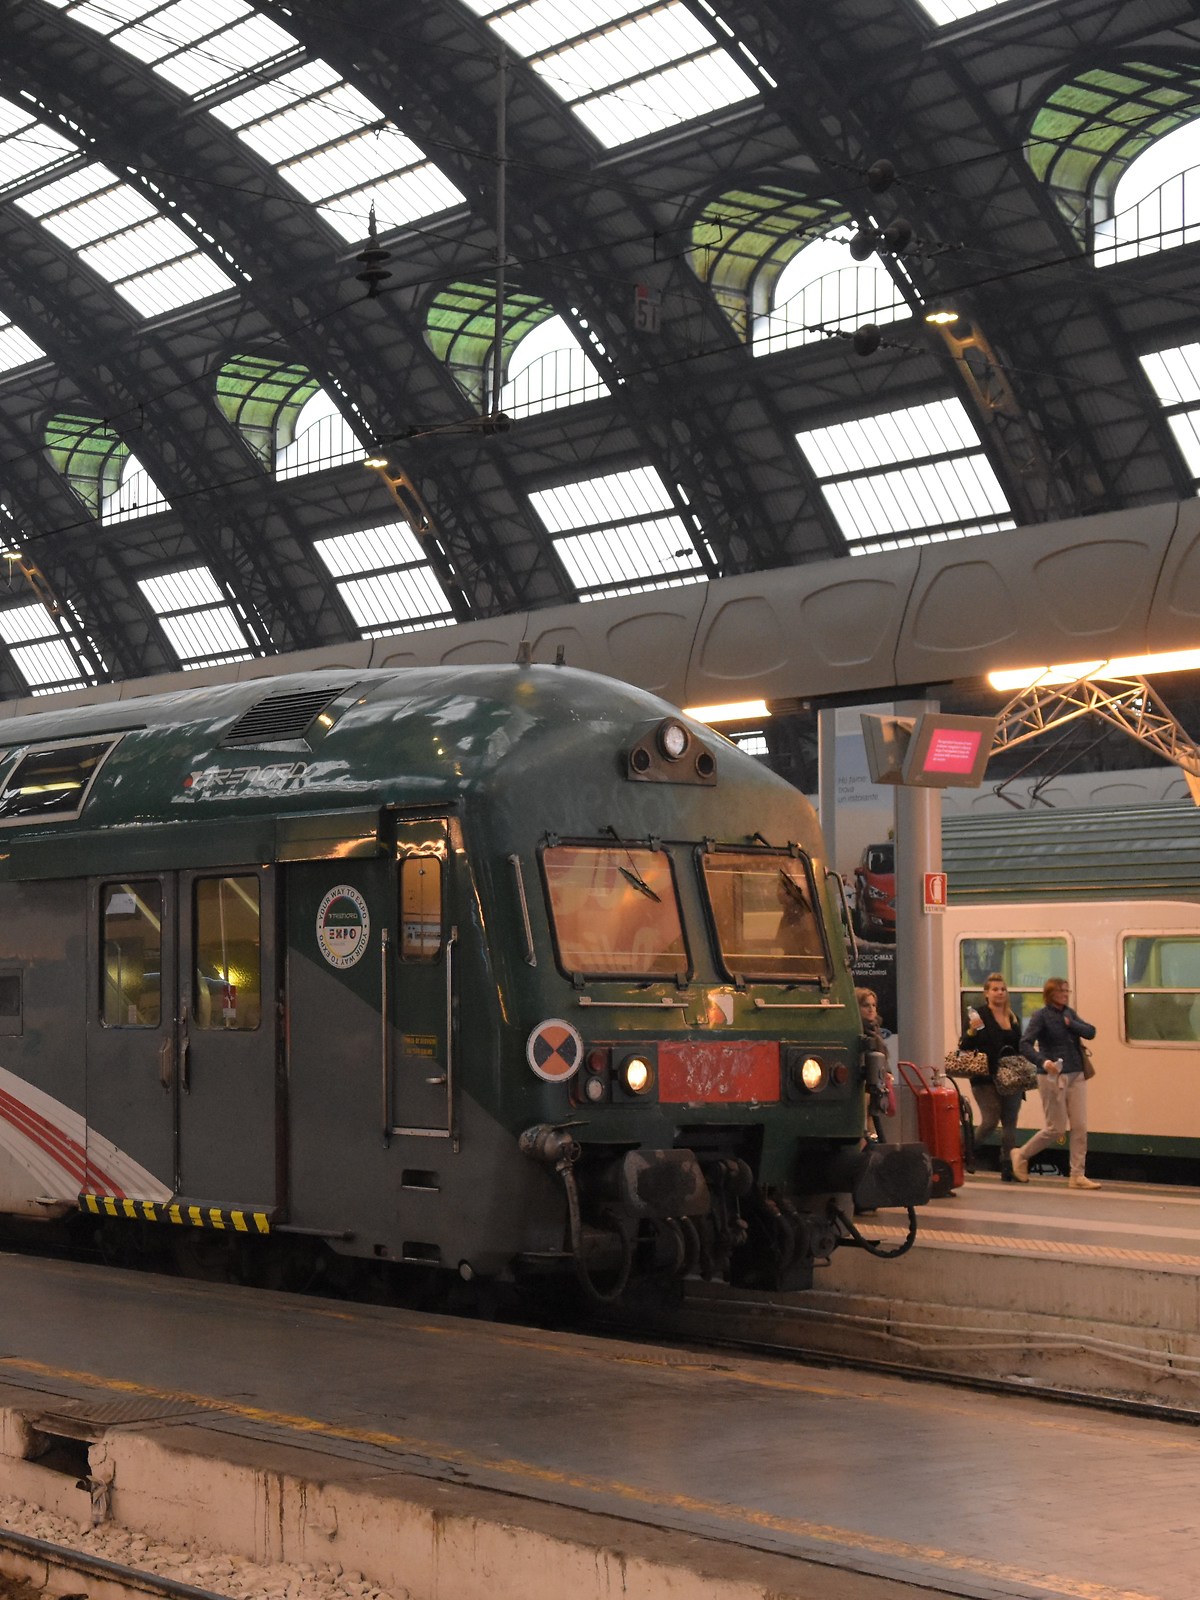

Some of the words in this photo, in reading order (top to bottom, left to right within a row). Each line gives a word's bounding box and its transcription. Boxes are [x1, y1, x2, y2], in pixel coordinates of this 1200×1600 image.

[202, 761, 308, 788] TRENORD
[319, 897, 331, 920] YOUR
[330, 888, 346, 899] WAY
[346, 888, 356, 898] TO
[355, 896, 368, 919] EXPO
[329, 928, 357, 940] EXPO
[356, 933, 368, 957] YOUR
[319, 935, 330, 957] EXPO
[330, 955, 340, 963] TO
[340, 957, 356, 966] WAY
